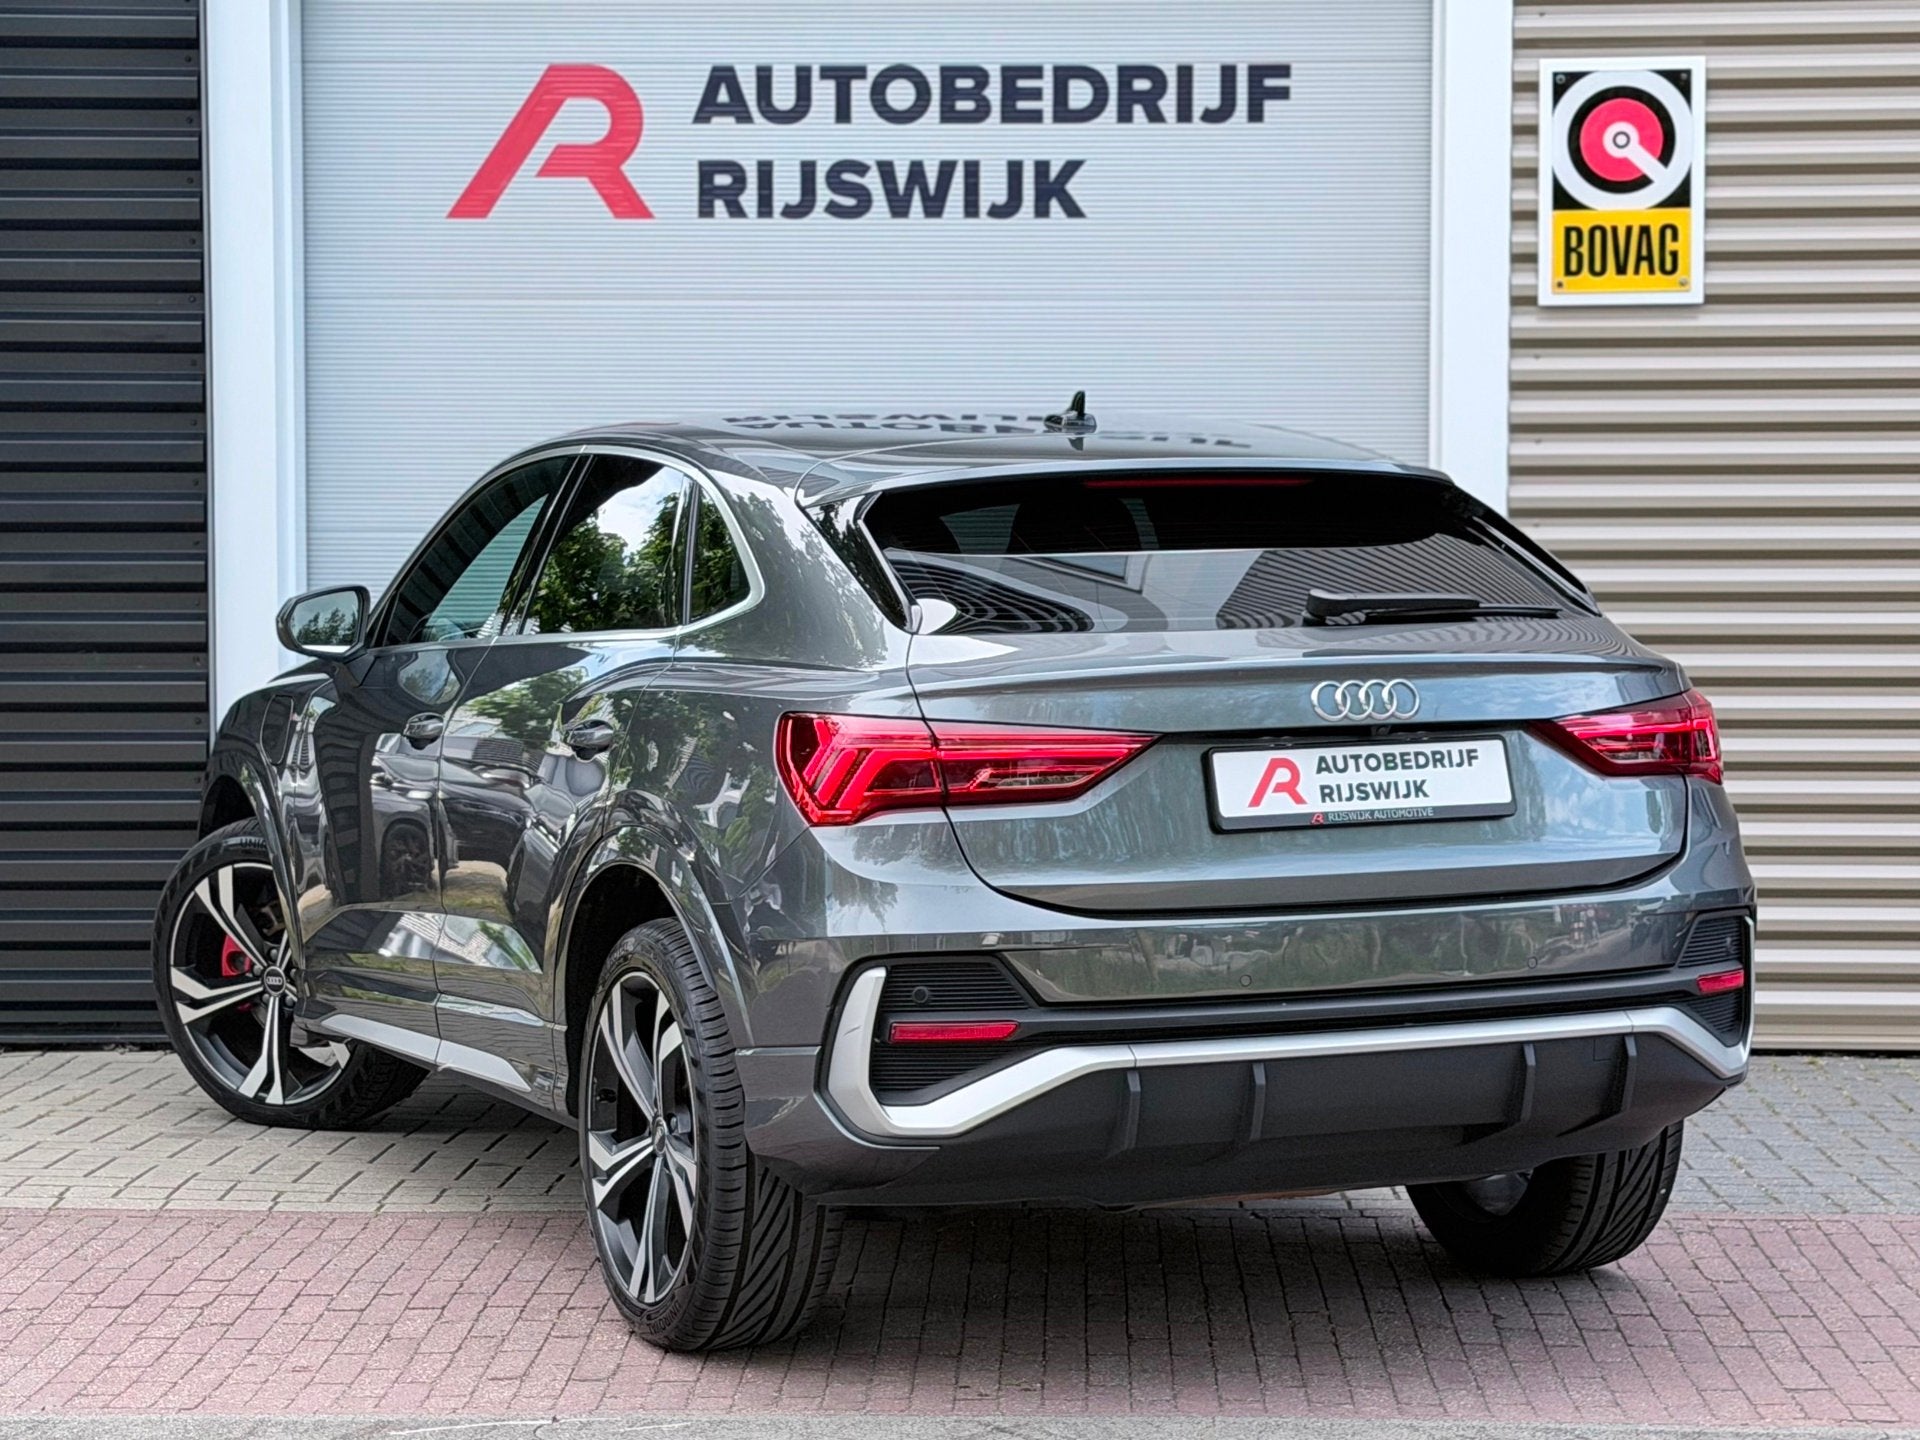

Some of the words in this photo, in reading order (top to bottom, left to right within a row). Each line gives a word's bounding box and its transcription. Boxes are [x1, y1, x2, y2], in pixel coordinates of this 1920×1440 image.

[692, 63, 1292, 125] AUTOBEDRIJF
[697, 158, 1086, 220] RIJSWIJK
[1563, 223, 1680, 278] BOVAG
[1316, 749, 1479, 774] AUTOBEDRIJF
[1319, 779, 1430, 803] RIJSWIJK
[1328, 809, 1372, 822] RIJSWIJK
[1374, 807, 1434, 820] AUTOMOTIVE
